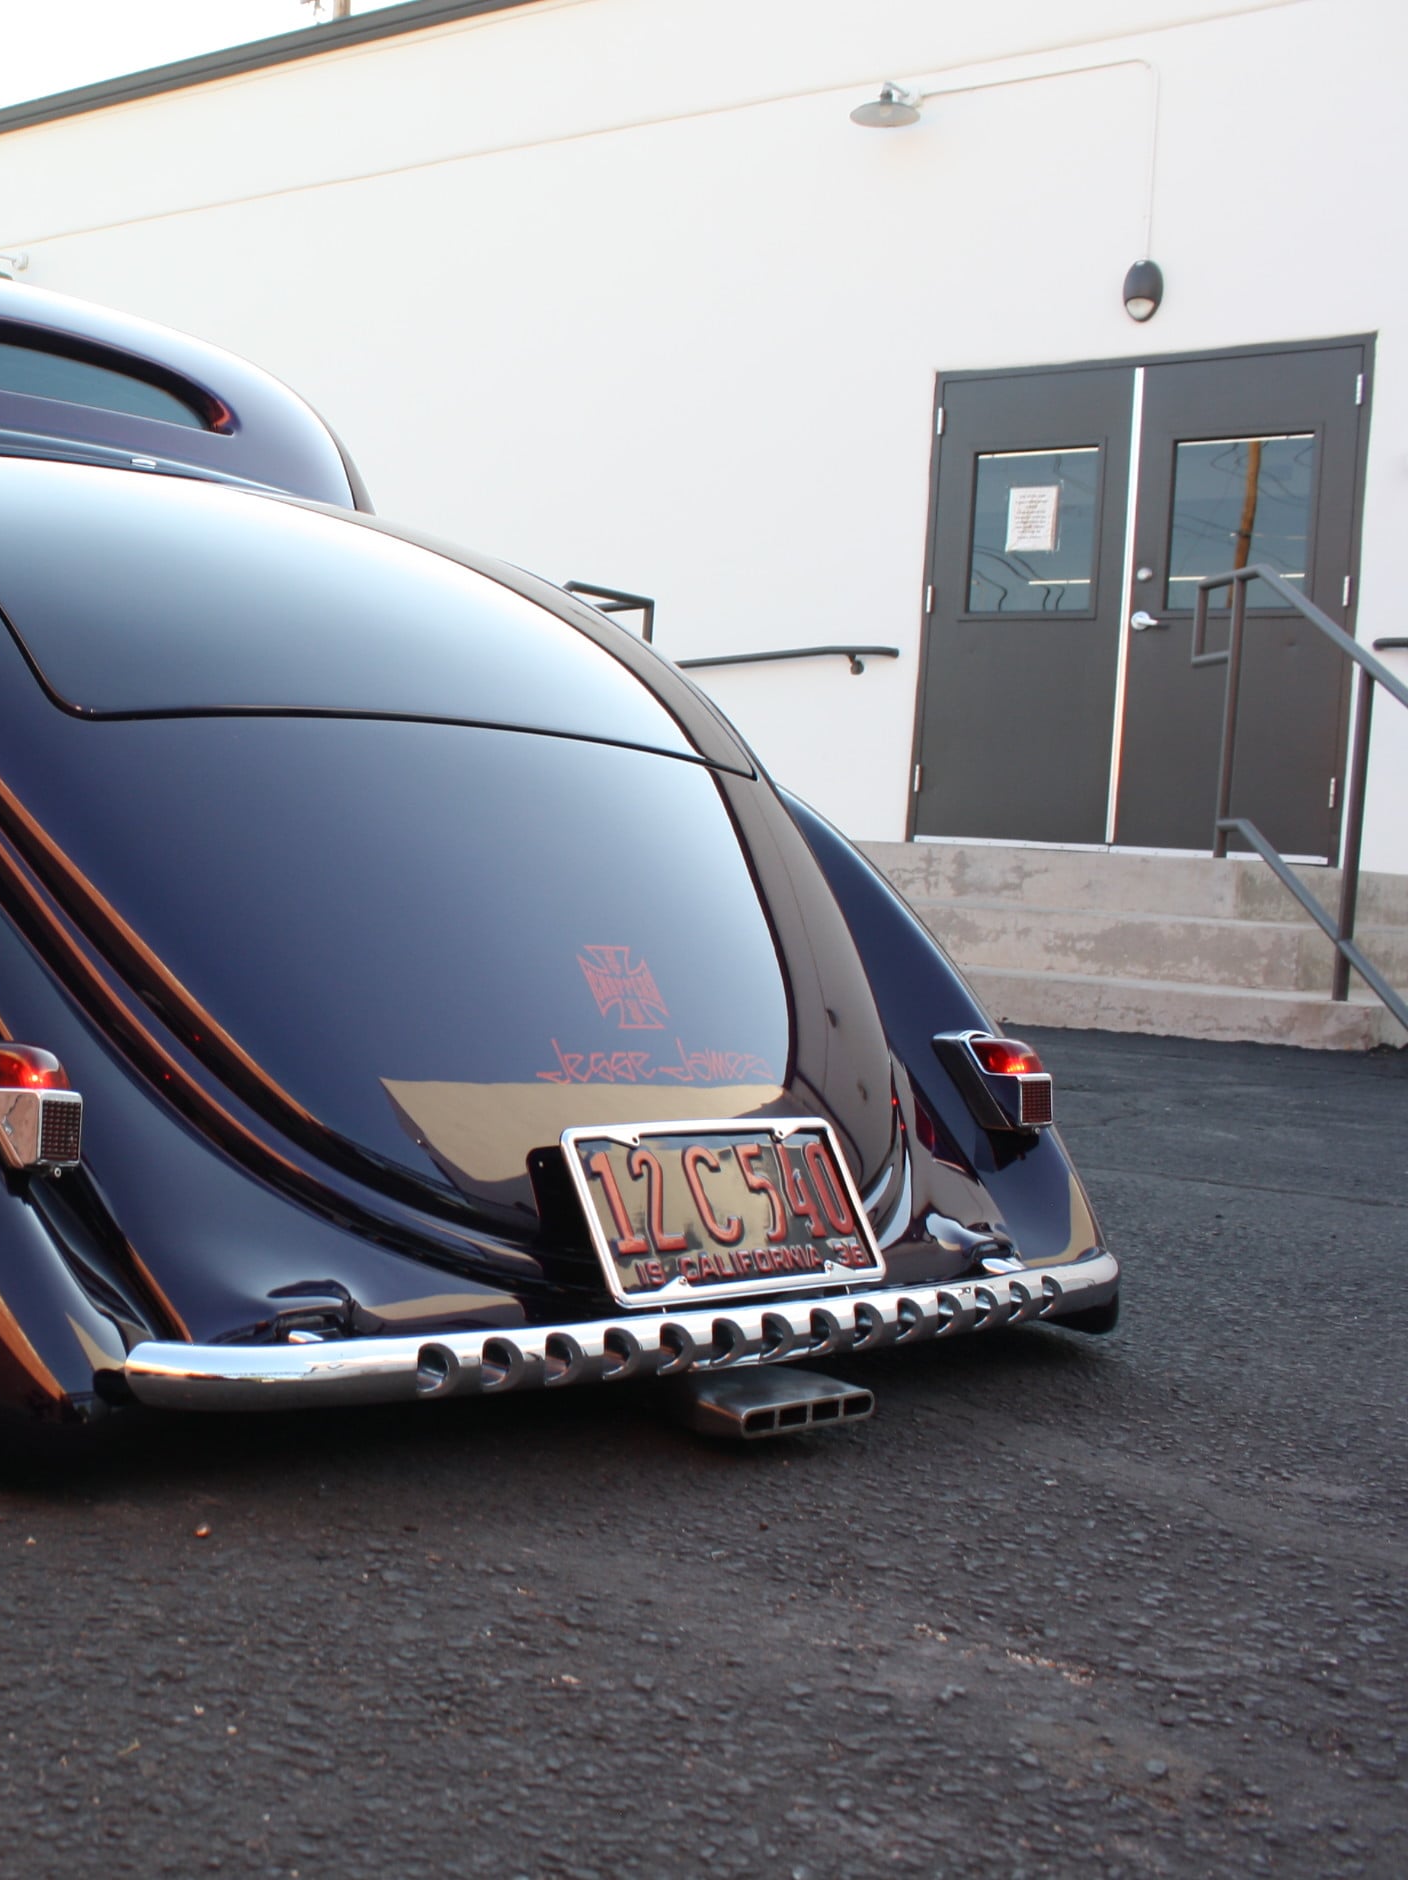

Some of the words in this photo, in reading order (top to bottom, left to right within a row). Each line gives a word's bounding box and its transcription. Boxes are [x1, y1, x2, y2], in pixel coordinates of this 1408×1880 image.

[536, 1038, 656, 1084] Jesse
[656, 1036, 776, 1082] James
[635, 1260, 666, 1286] 19
[678, 1244, 823, 1282] CALIFORNIA
